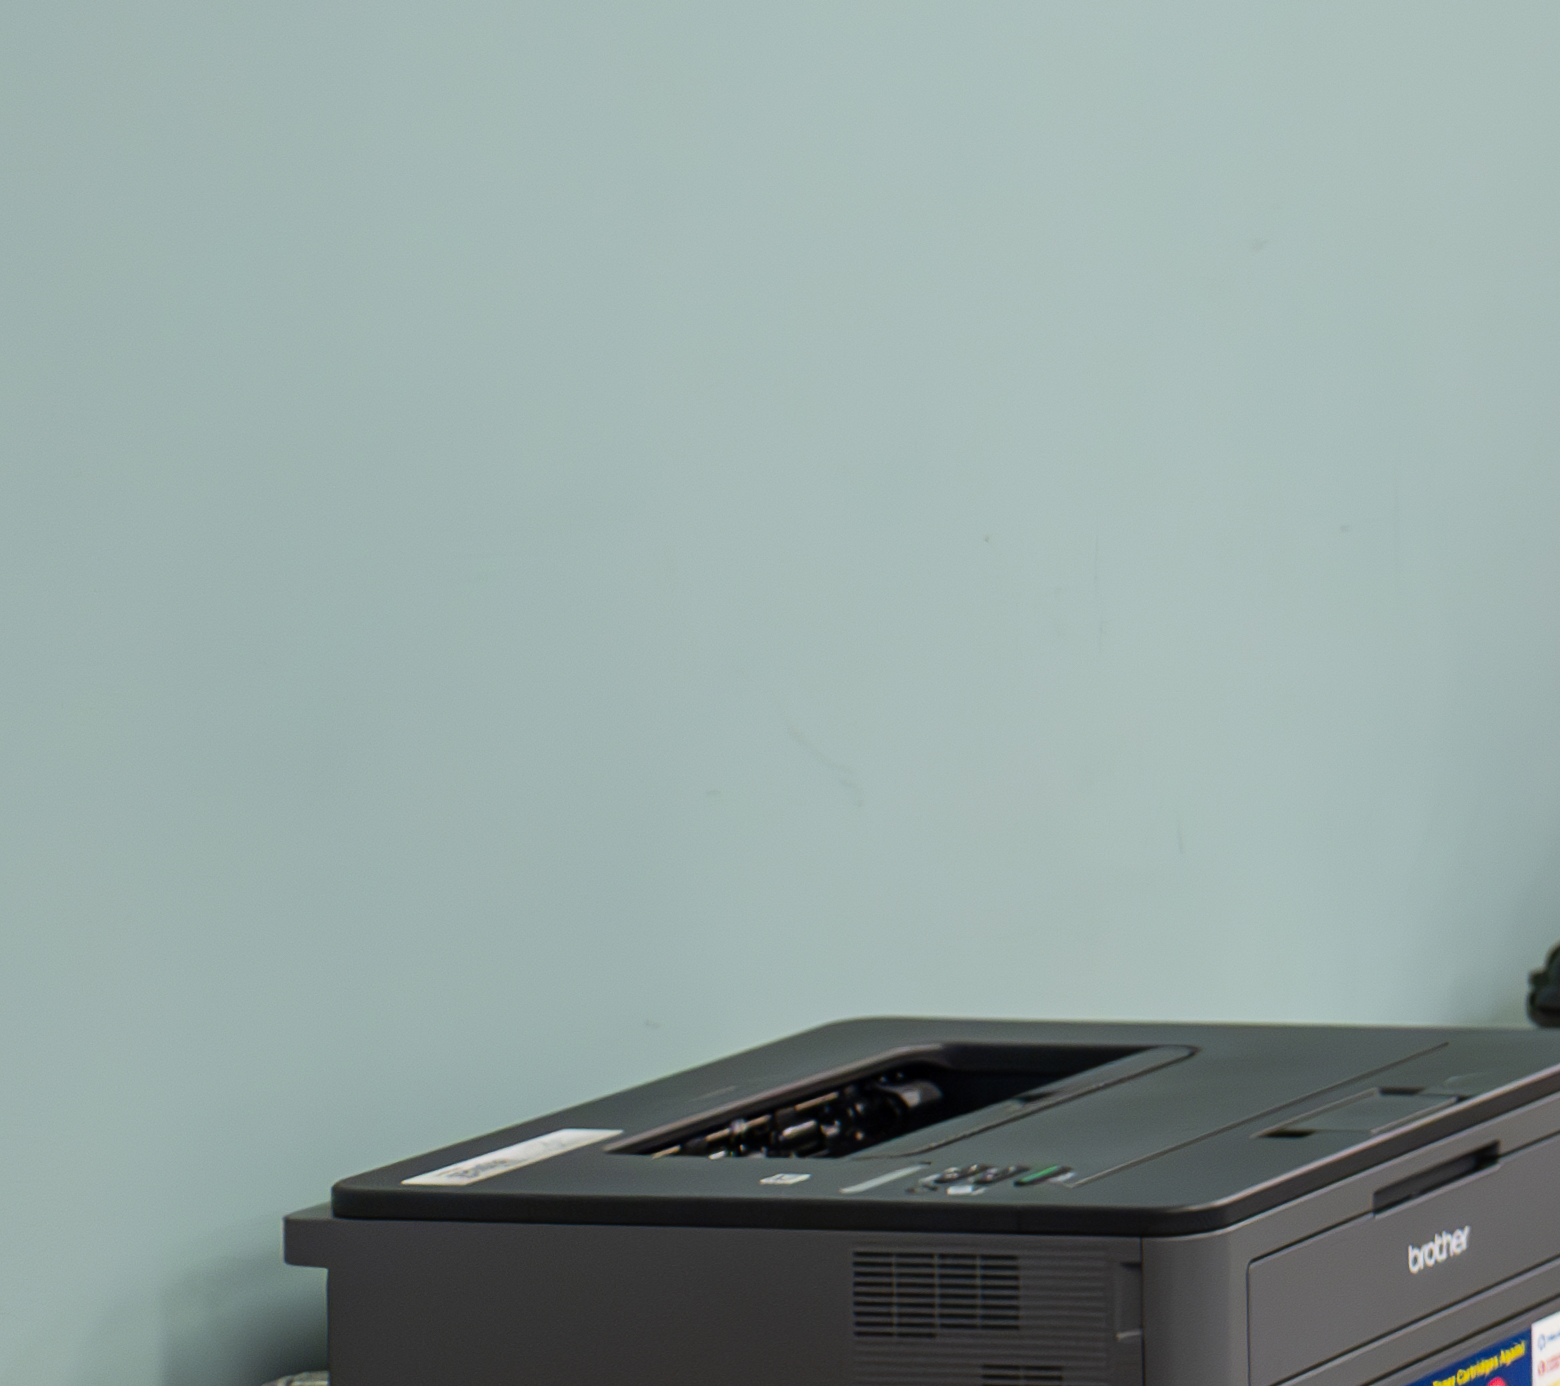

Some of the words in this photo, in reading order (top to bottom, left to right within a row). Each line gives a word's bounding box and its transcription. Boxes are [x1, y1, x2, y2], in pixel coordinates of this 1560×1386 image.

[1408, 1226, 1470, 1273] brother
[1457, 1355, 1499, 1386] Cartridges
[1500, 1339, 1525, 1366] Again!
